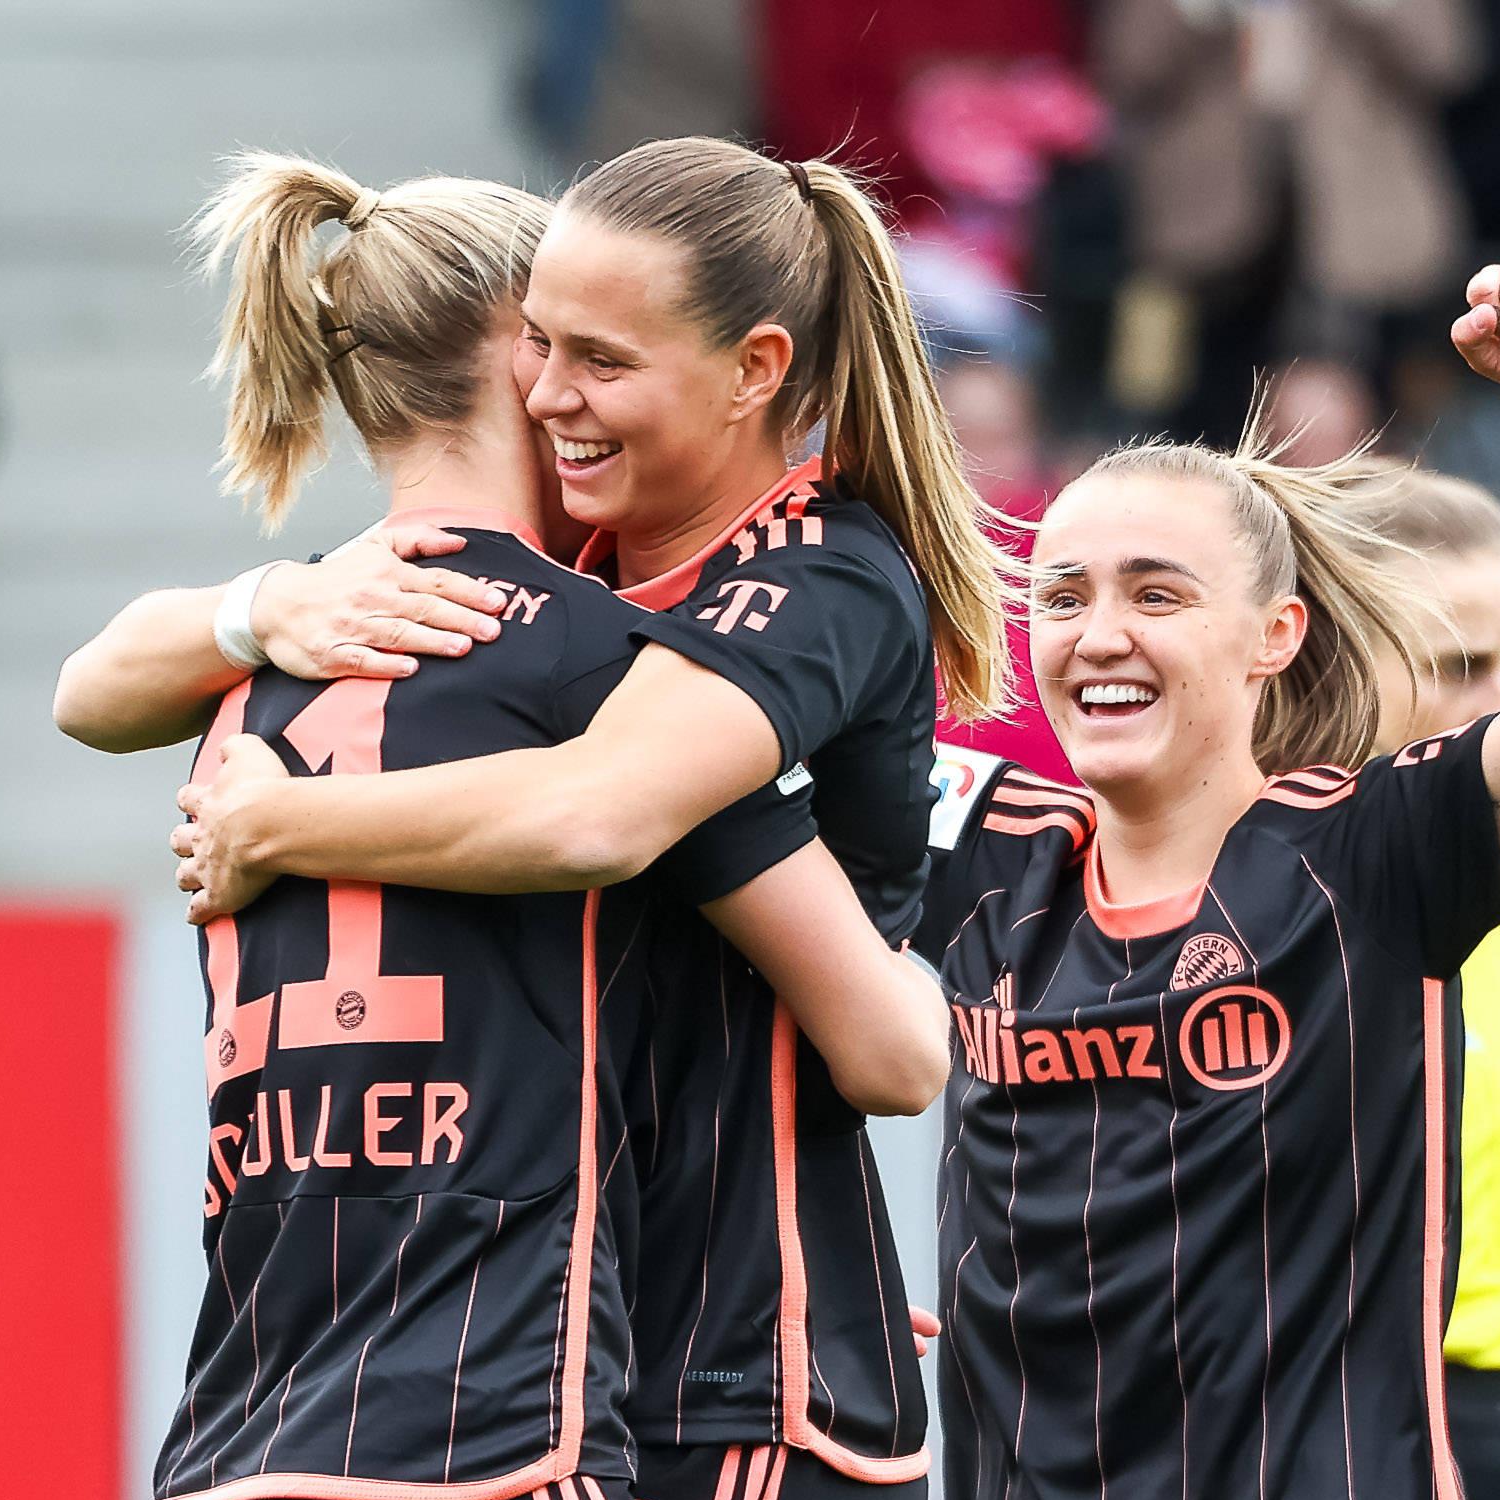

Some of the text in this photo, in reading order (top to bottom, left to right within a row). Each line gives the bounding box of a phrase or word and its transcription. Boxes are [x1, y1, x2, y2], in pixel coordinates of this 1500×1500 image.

[1175, 938, 1229, 983] FC BAYERN
[952, 1004, 1162, 1086] Allianz
[684, 1370, 744, 1383] AEROREADY
